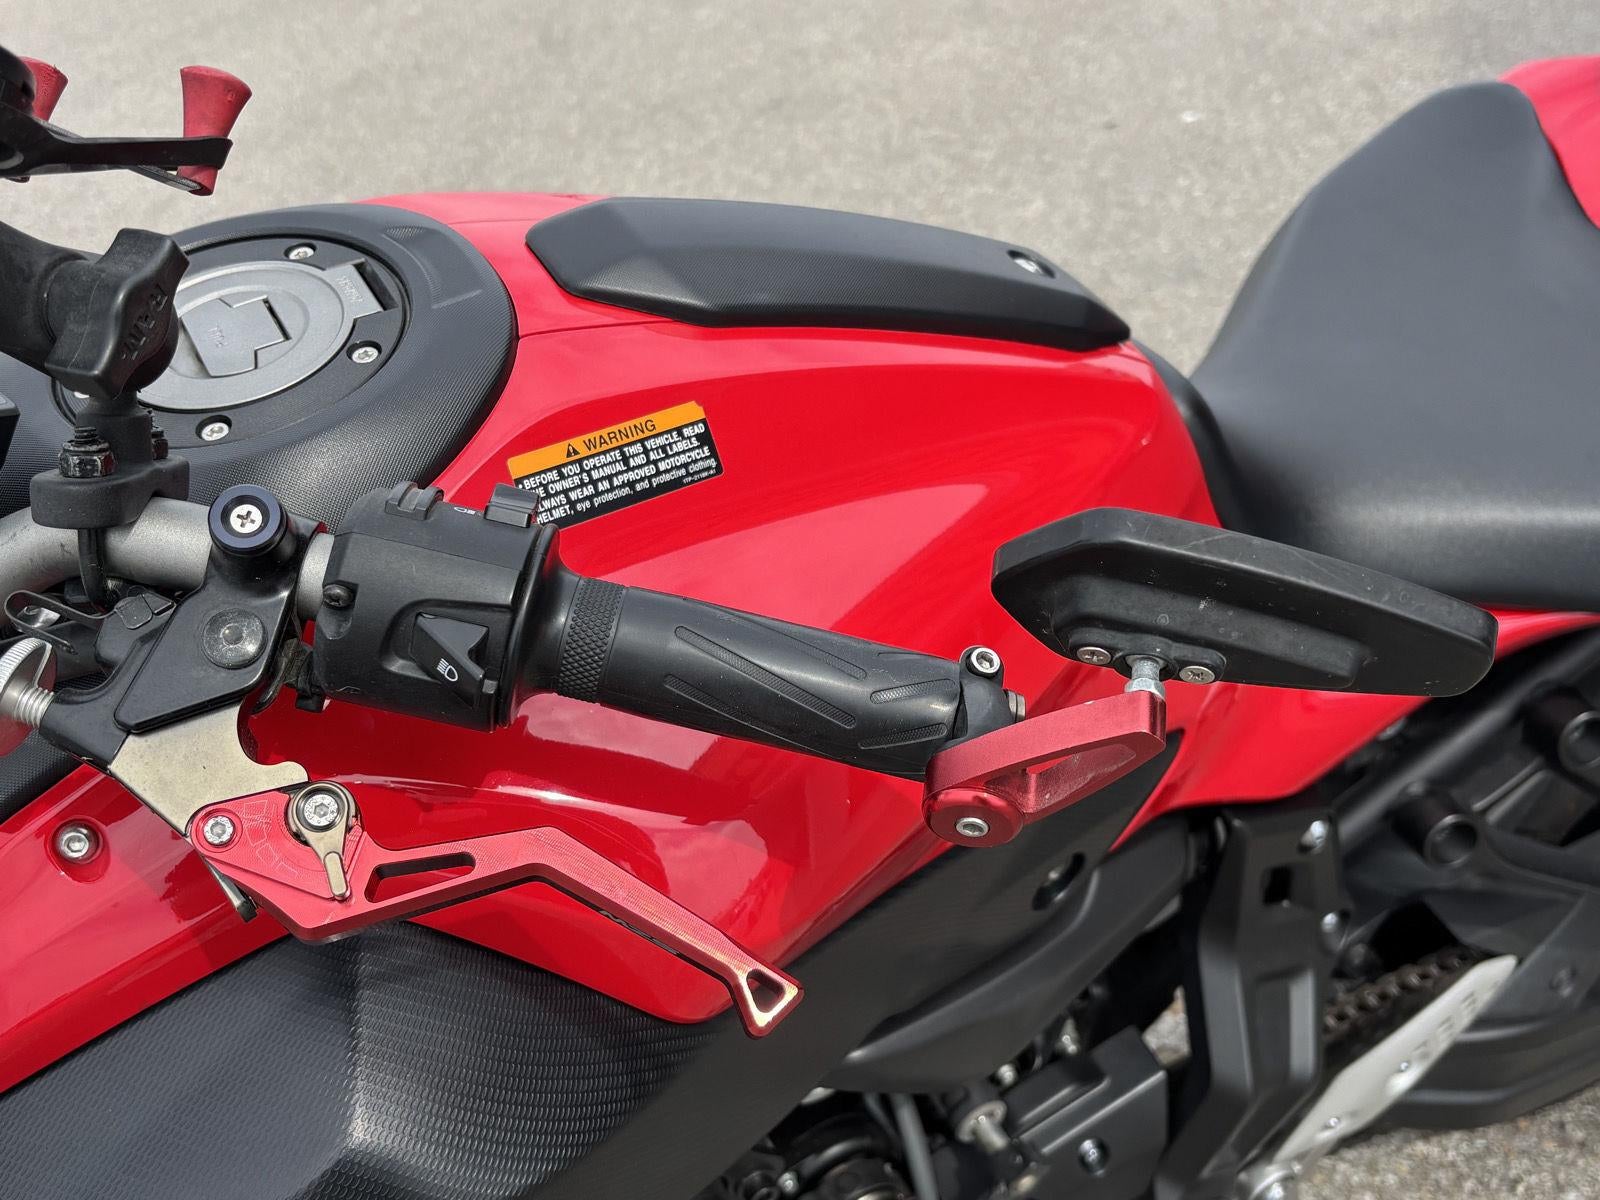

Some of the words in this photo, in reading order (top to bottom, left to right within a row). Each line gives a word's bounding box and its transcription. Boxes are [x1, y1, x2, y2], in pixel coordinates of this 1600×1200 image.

[523, 470, 560, 490] BEFORE
[561, 463, 580, 477] YOU
[583, 450, 622, 471] OPERATE
[623, 442, 643, 457] THIS
[645, 431, 682, 450] VEHICLE,
[683, 422, 706, 438] READ
[582, 419, 657, 451] WARNING
[537, 493, 567, 512] LWAYS
[568, 484, 596, 502] WEAR
[598, 479, 611, 492] AN
[613, 464, 656, 487] APPROVED
[658, 446, 711, 472] MOTORCYCLE
[548, 472, 590, 494] OWNER'S
[591, 460, 628, 480] MANUAL
[629, 453, 647, 468] AND
[649, 448, 665, 461] ALL
[667, 437, 701, 455] LABELS.
[576, 500, 592, 512] eye
[593, 485, 634, 508] protection,
[635, 479, 650, 492] and
[651, 467, 687, 488] protective
[688, 457, 717, 474] clothing.
